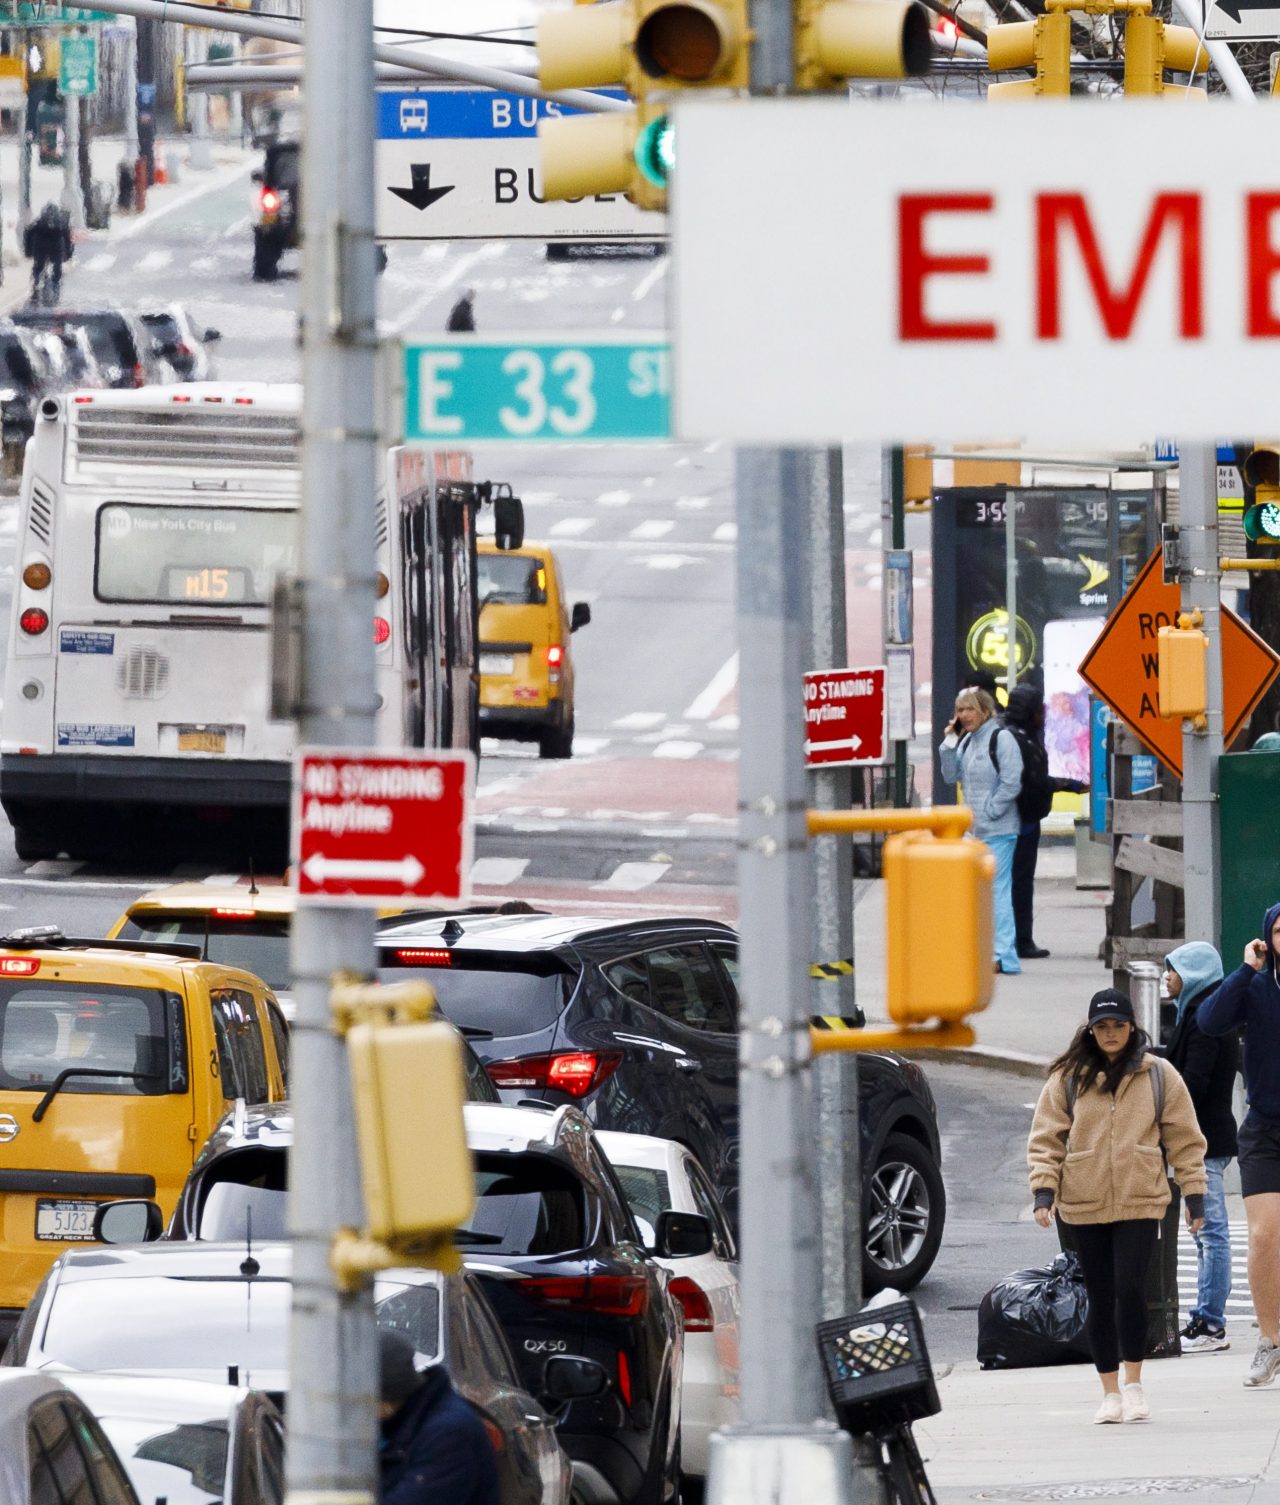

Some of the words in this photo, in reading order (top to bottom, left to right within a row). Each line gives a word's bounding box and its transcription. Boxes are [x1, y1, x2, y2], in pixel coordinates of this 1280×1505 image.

[491, 98, 564, 129] BUS
[417, 350, 465, 435] E
[499, 349, 598, 436] 33
[1086, 502, 1108, 523] 45
[134, 517, 159, 530] New
[160, 518, 185, 531] York
[187, 518, 212, 533] City
[214, 519, 237, 533] Bus
[185, 567, 230, 599] M15
[1079, 593, 1109, 606] Sprint
[819, 678, 874, 700] STANDING
[305, 761, 337, 797] NO
[339, 763, 445, 801] STANDING
[305, 797, 394, 838] Anytime
[55, 1211, 94, 1231] 5J23
[524, 1338, 567, 1354] QX50
